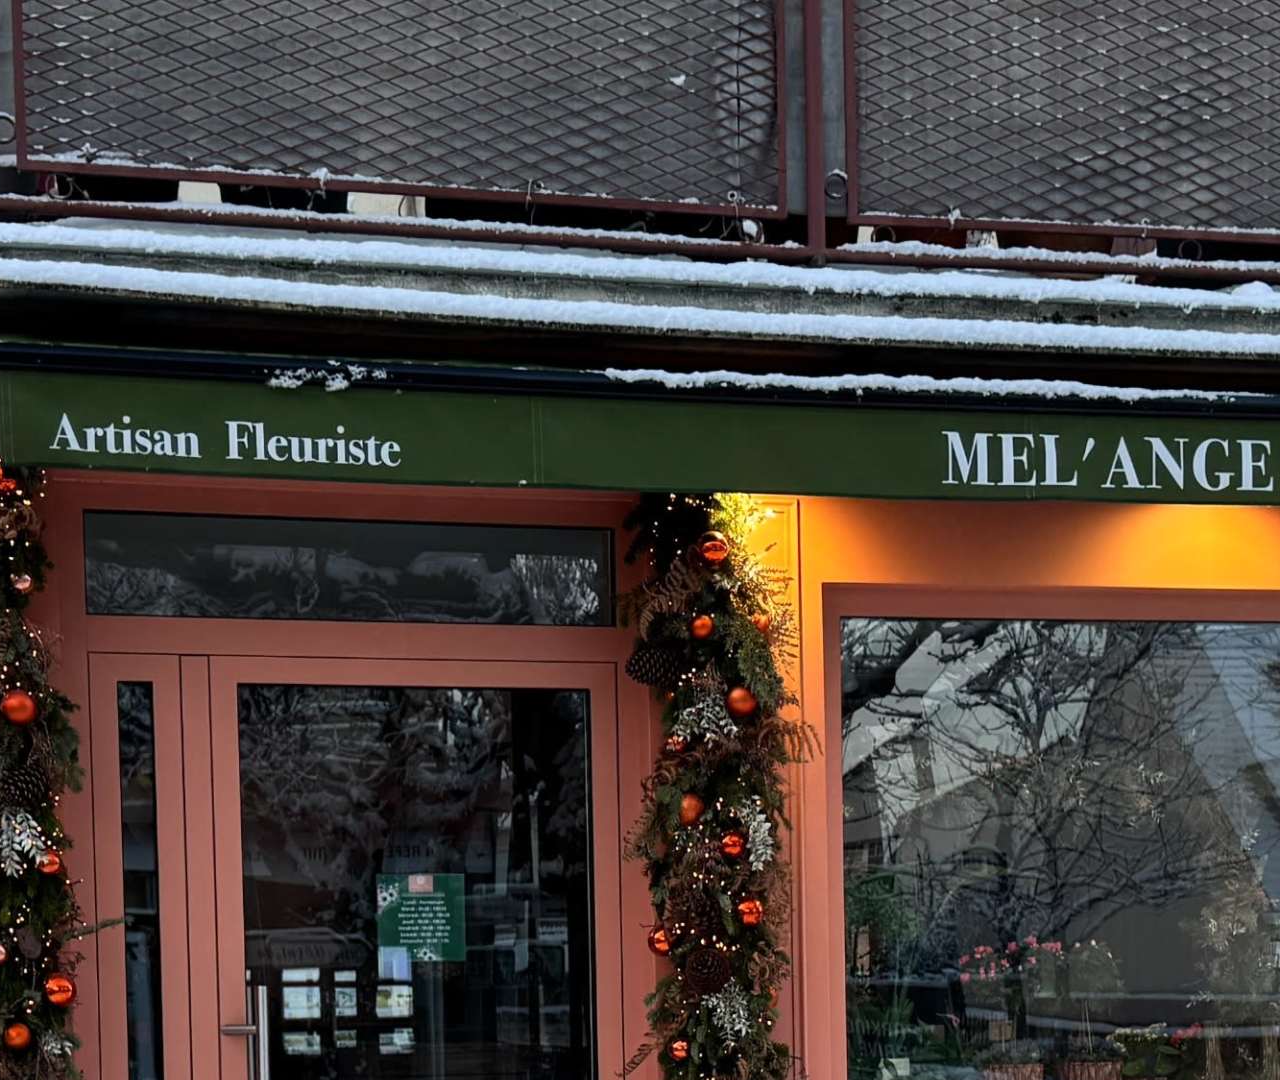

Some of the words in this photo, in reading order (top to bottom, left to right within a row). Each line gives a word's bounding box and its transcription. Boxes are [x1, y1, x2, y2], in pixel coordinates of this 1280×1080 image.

[49, 412, 202, 459] Artisan
[225, 420, 402, 468] Fleuriste
[941, 430, 1275, 493] MEL'ANGE
